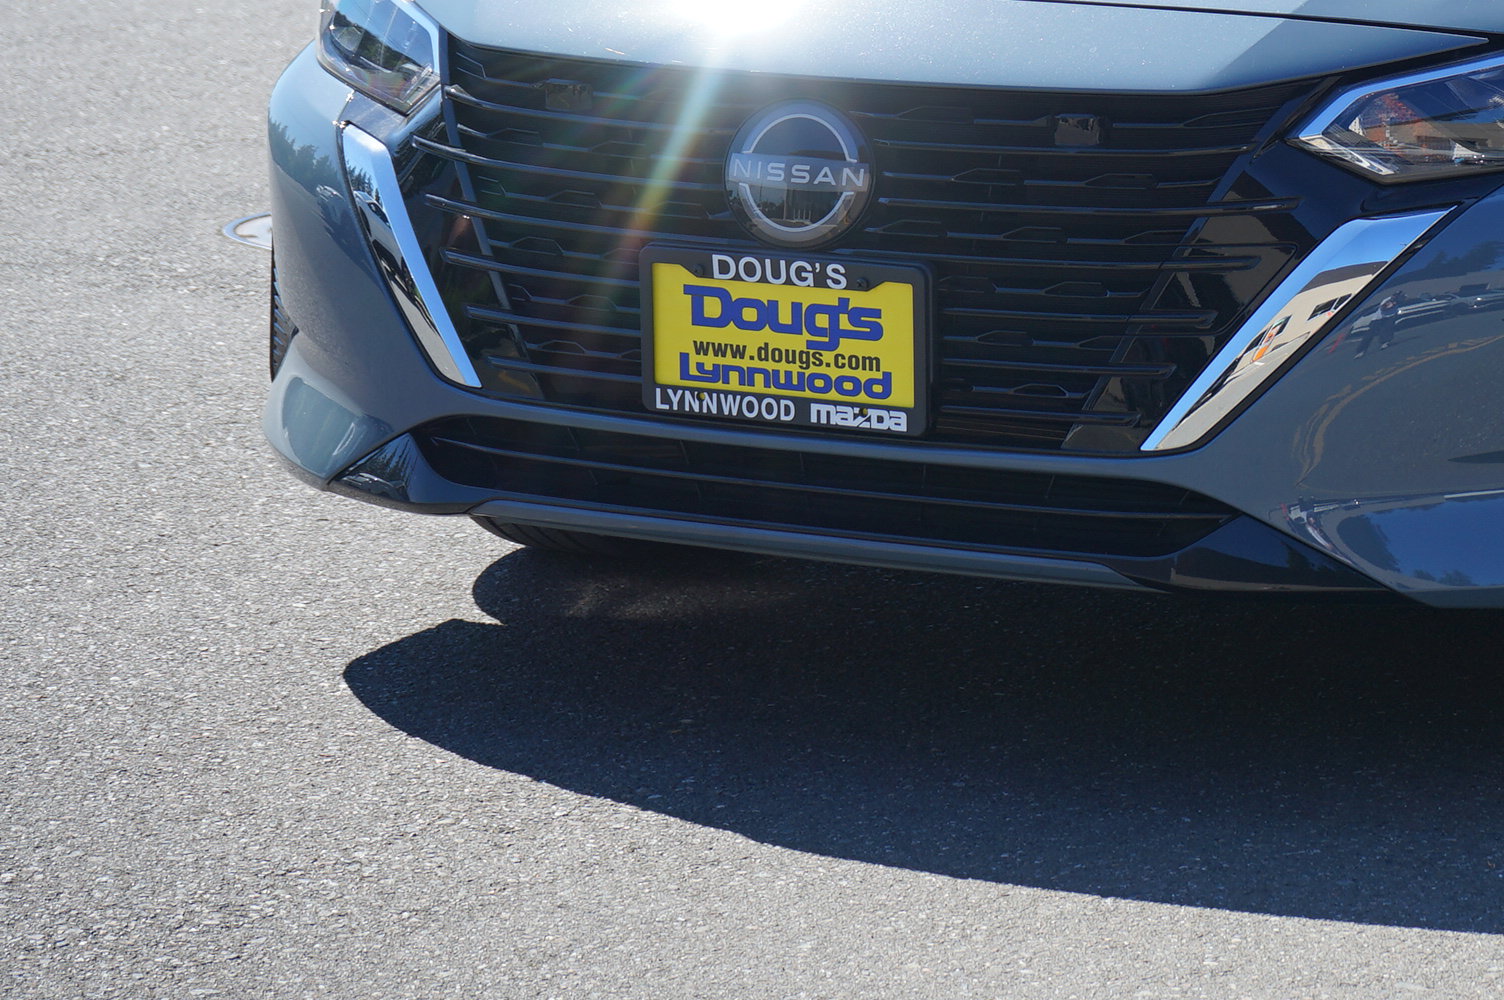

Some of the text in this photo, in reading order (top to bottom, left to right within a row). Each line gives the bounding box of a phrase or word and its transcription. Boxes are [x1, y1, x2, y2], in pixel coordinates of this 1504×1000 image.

[733, 158, 865, 187] NISSAN
[711, 253, 848, 290] DOUG'S
[693, 340, 881, 372] www.dougs.com
[679, 352, 892, 400] Lynnwood
[655, 387, 796, 422] LYNNWOOD
